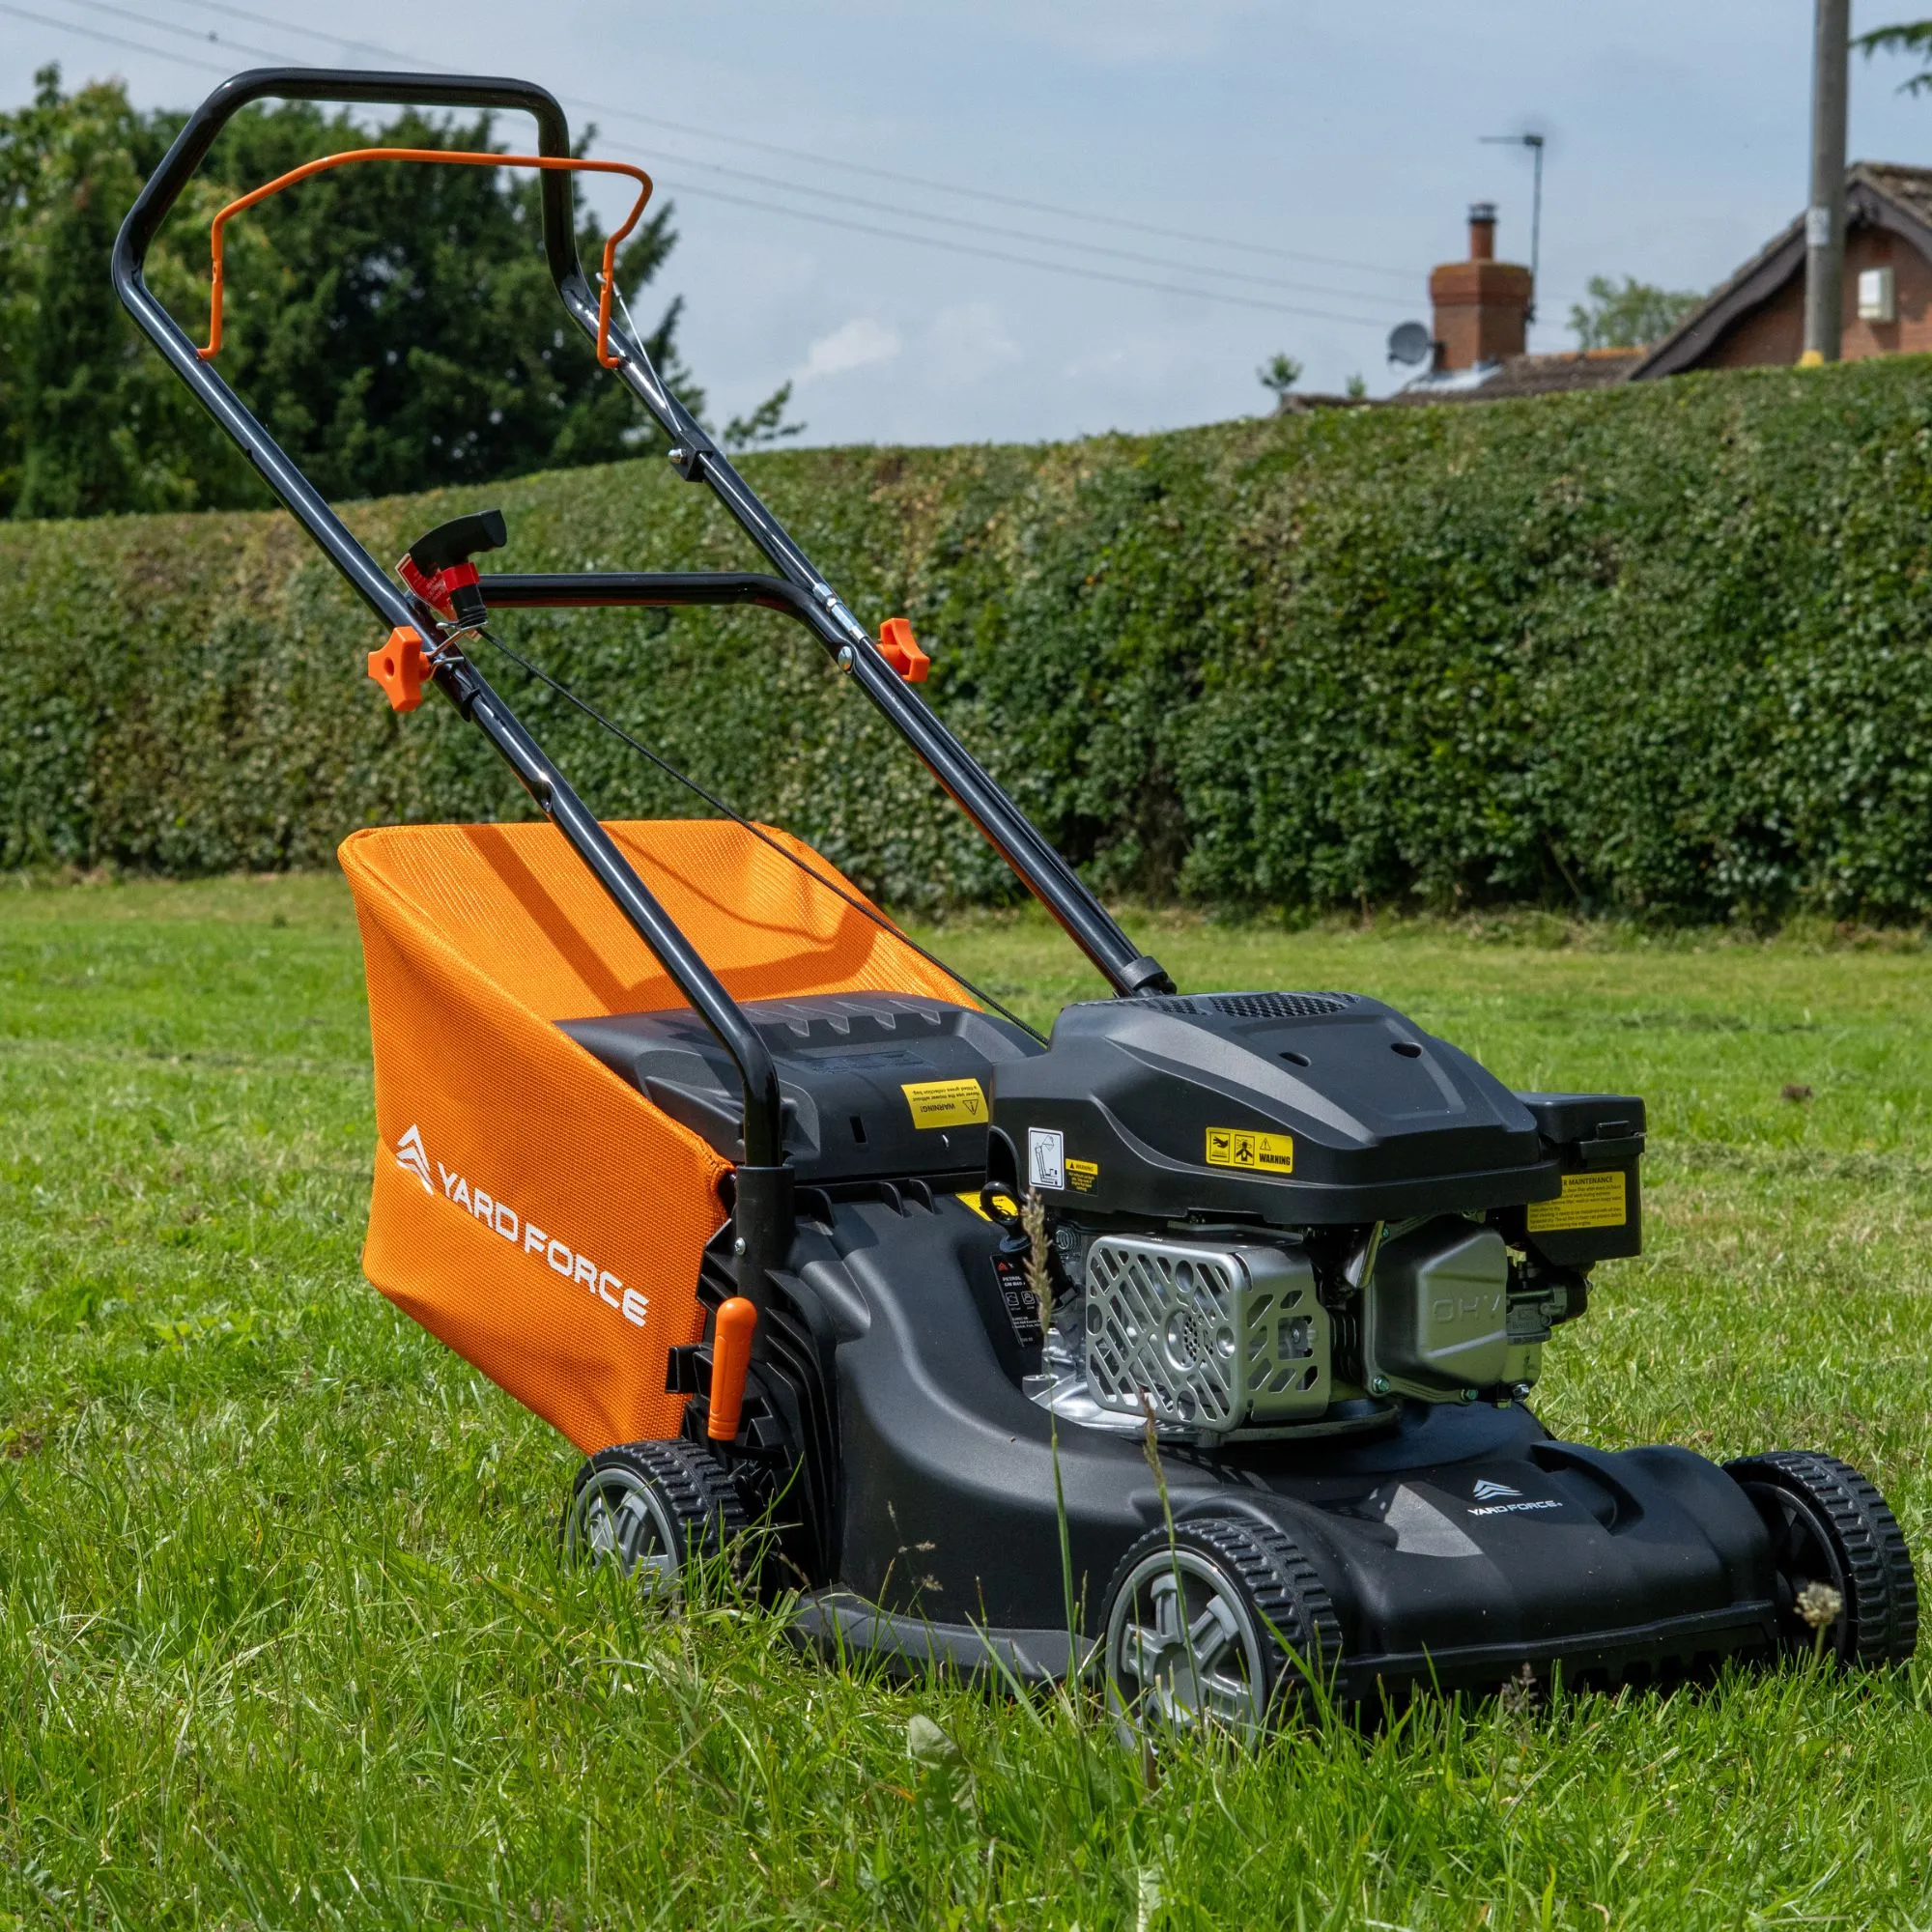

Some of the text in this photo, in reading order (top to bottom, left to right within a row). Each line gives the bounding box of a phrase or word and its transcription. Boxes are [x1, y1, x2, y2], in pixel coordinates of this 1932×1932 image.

[920, 1103, 955, 1113] WARNING!
[1259, 1152, 1291, 1165] WARNING
[1569, 1176, 1613, 1186] MAINTENANCE
[437, 1160, 650, 1328] YARD FORCE
[1467, 1506, 1508, 1516] YARD
